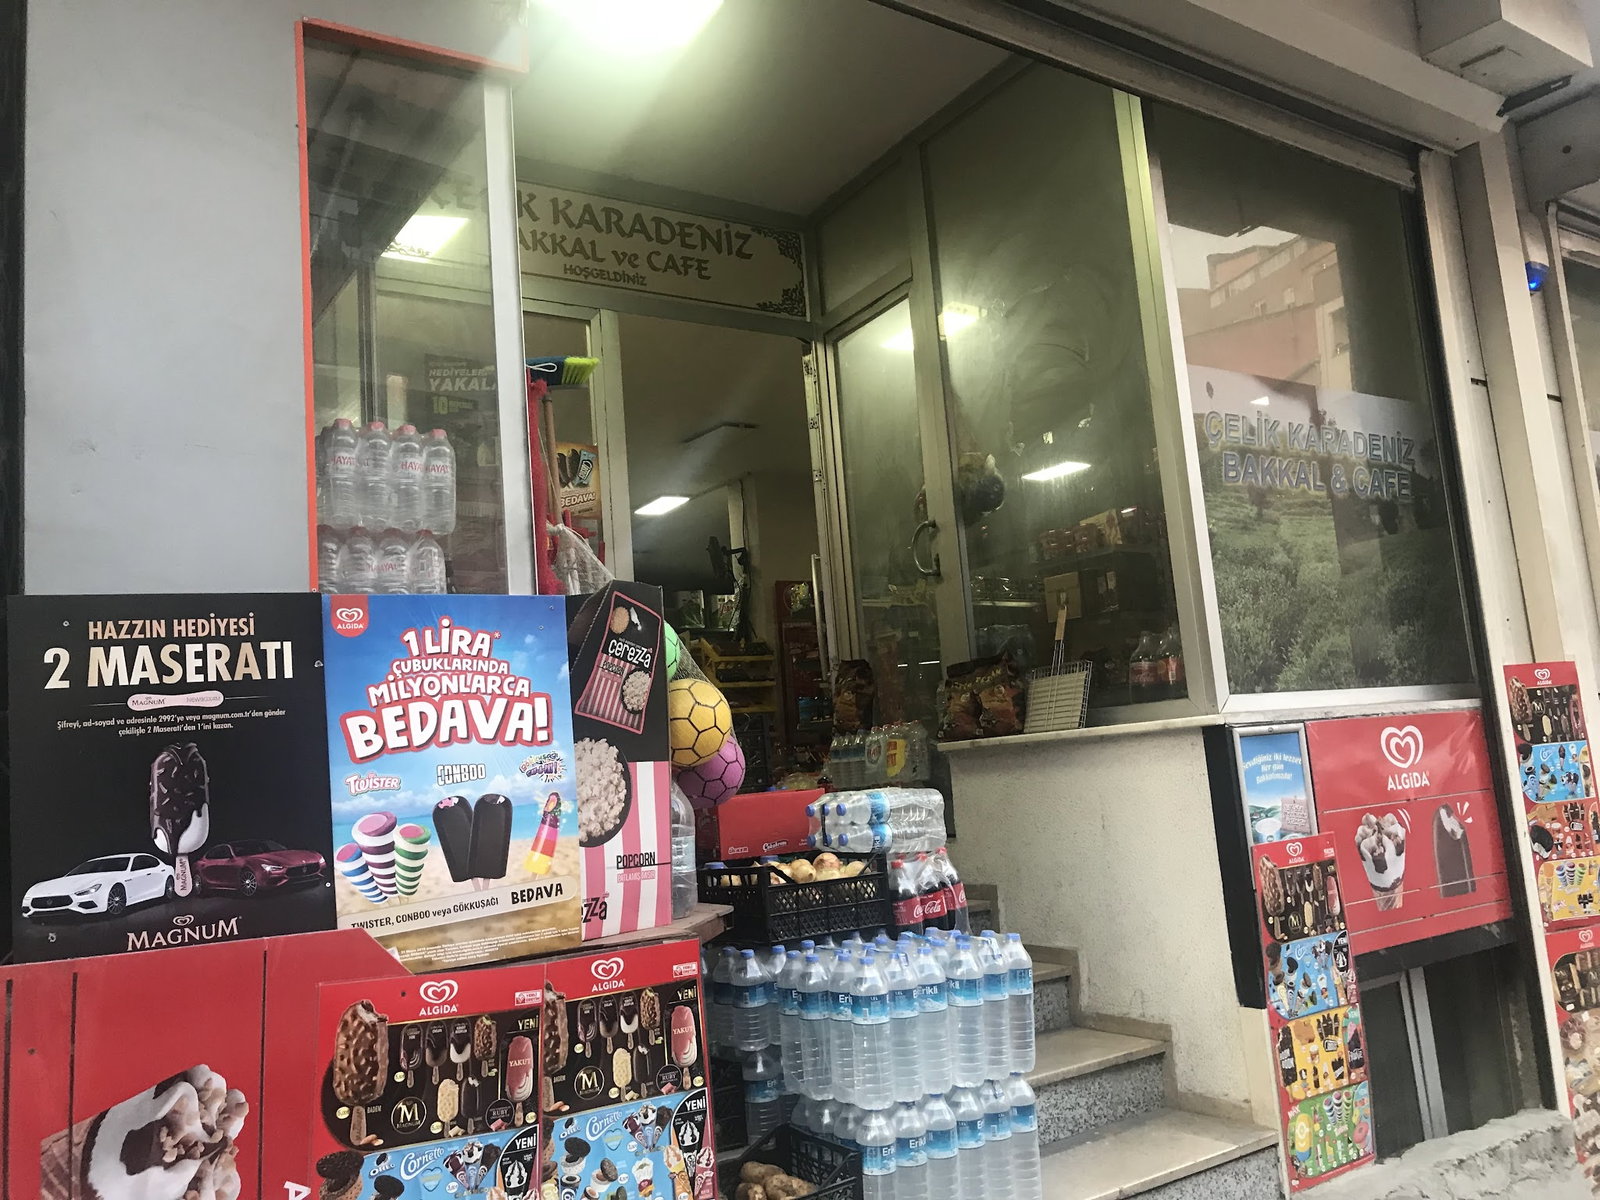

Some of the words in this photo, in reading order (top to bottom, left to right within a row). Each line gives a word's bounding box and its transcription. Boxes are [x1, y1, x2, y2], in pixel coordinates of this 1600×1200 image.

[550, 197, 752, 260] KARADENİZ
[563, 263, 648, 287] HOŞGELDİNİZ
[611, 249, 640, 269] ve
[646, 251, 712, 281] CAFE
[1204, 410, 1281, 449] ÇELİK
[1288, 421, 1416, 466] KARADENİZ
[1222, 451, 1326, 492] BAKKAL
[1330, 464, 1348, 495] &
[1353, 465, 1413, 498] CAFE
[88, 619, 166, 640] HAZZIN
[173, 612, 255, 638] HEDİYESİ
[403, 631, 421, 658] 1
[424, 619, 492, 658] LİRA
[43, 647, 71, 690] 2
[87, 641, 294, 688] MASERATI
[392, 658, 509, 678] ÇUBUKLARINDA
[368, 674, 531, 708] MİLYONLARCA
[57, 719, 82, 731] Şifreyi,
[82, 717, 116, 728] ad-soyad
[116, 718, 126, 726] ve
[126, 714, 158, 726] adresinle
[158, 714, 185, 725] 2992'ye
[185, 713, 201, 723] veya
[264, 708, 286, 718] gönder
[118, 727, 147, 738] çekilişle
[147, 726, 153, 734] 2
[153, 723, 197, 734] Maserati'den
[212, 721, 234, 731] kazan.
[345, 695, 549, 761] BEDAVA!
[345, 773, 401, 795] TWISTER
[436, 762, 487, 786] CONBOO
[616, 851, 656, 869] POPCORN
[396, 911, 431, 926] CONBOO
[431, 905, 452, 918] veya
[511, 883, 564, 905] BEDAVA
[126, 916, 239, 952] MAGNUM
[677, 985, 697, 1001] YENİ
[517, 1014, 540, 1031] YENİ
[684, 1095, 707, 1112] YENİ
[585, 1110, 624, 1142] Cornetto
[514, 1133, 538, 1150] YENİ
[400, 1146, 445, 1180] Cornetto
